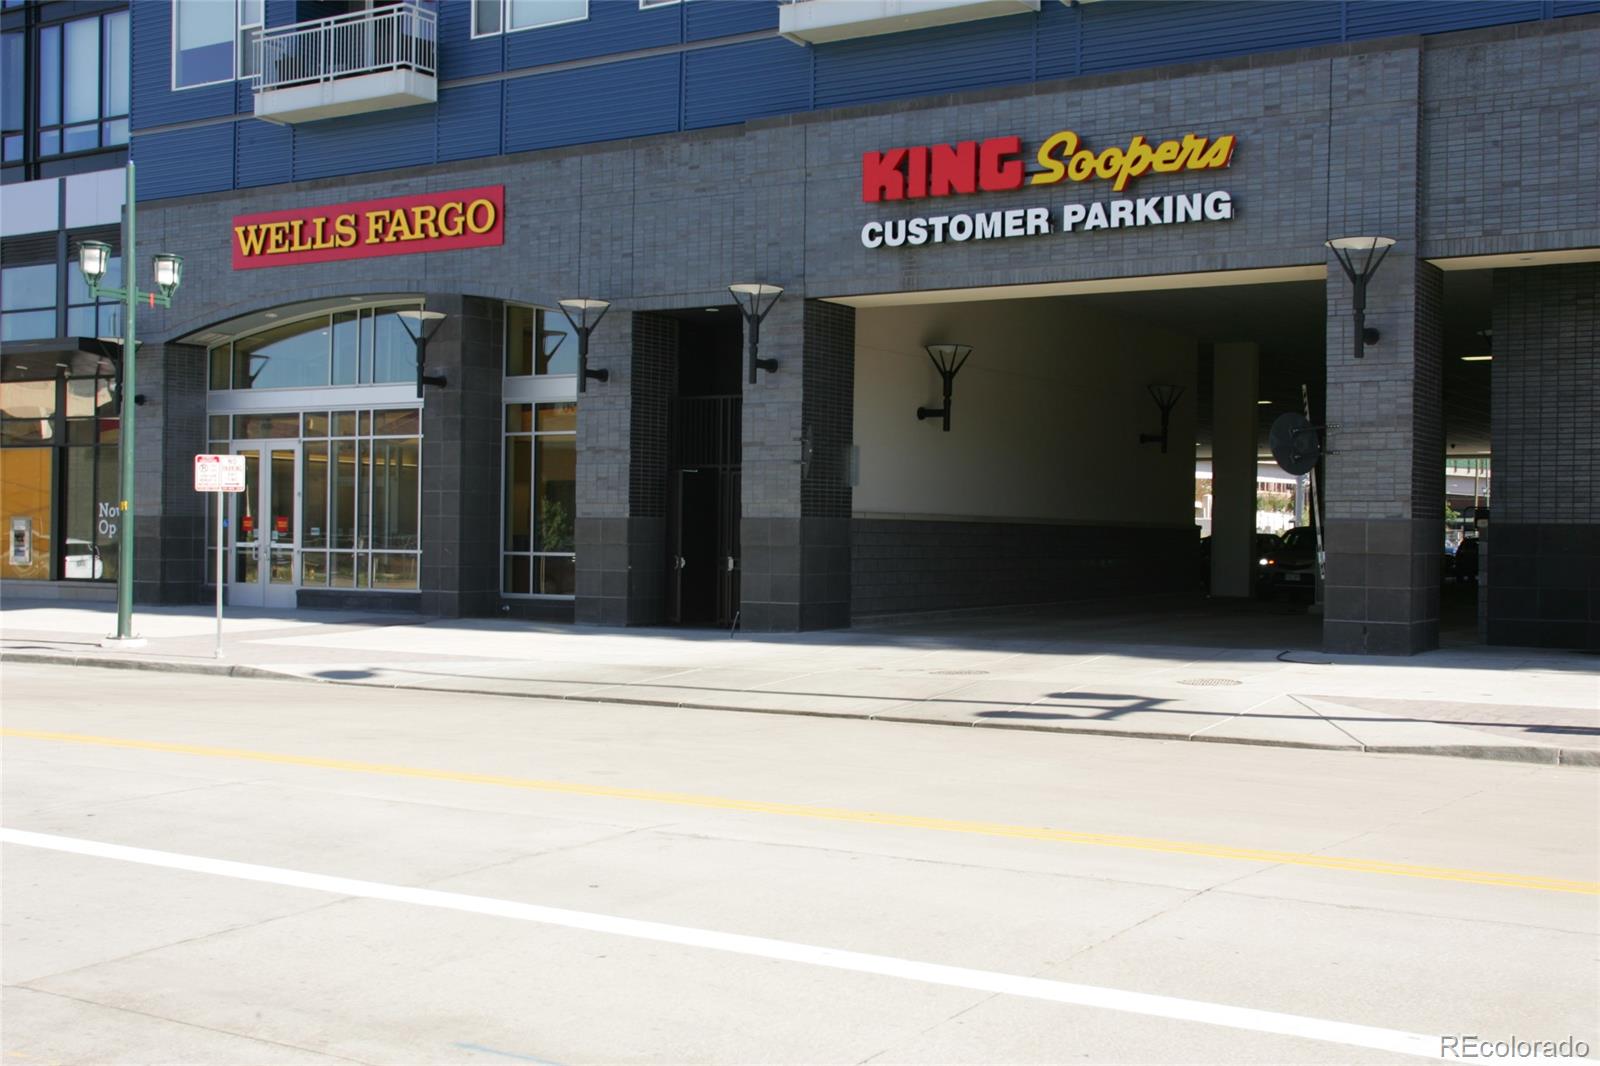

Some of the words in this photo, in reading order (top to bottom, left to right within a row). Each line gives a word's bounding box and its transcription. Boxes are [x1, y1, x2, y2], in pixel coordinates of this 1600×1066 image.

[862, 136, 1024, 203] KING
[1031, 130, 1236, 192] Soopers
[234, 214, 357, 256] WELLS
[365, 199, 496, 244] FARGO
[861, 207, 1050, 248] CUSTOMER
[1063, 190, 1233, 232] PARKING
